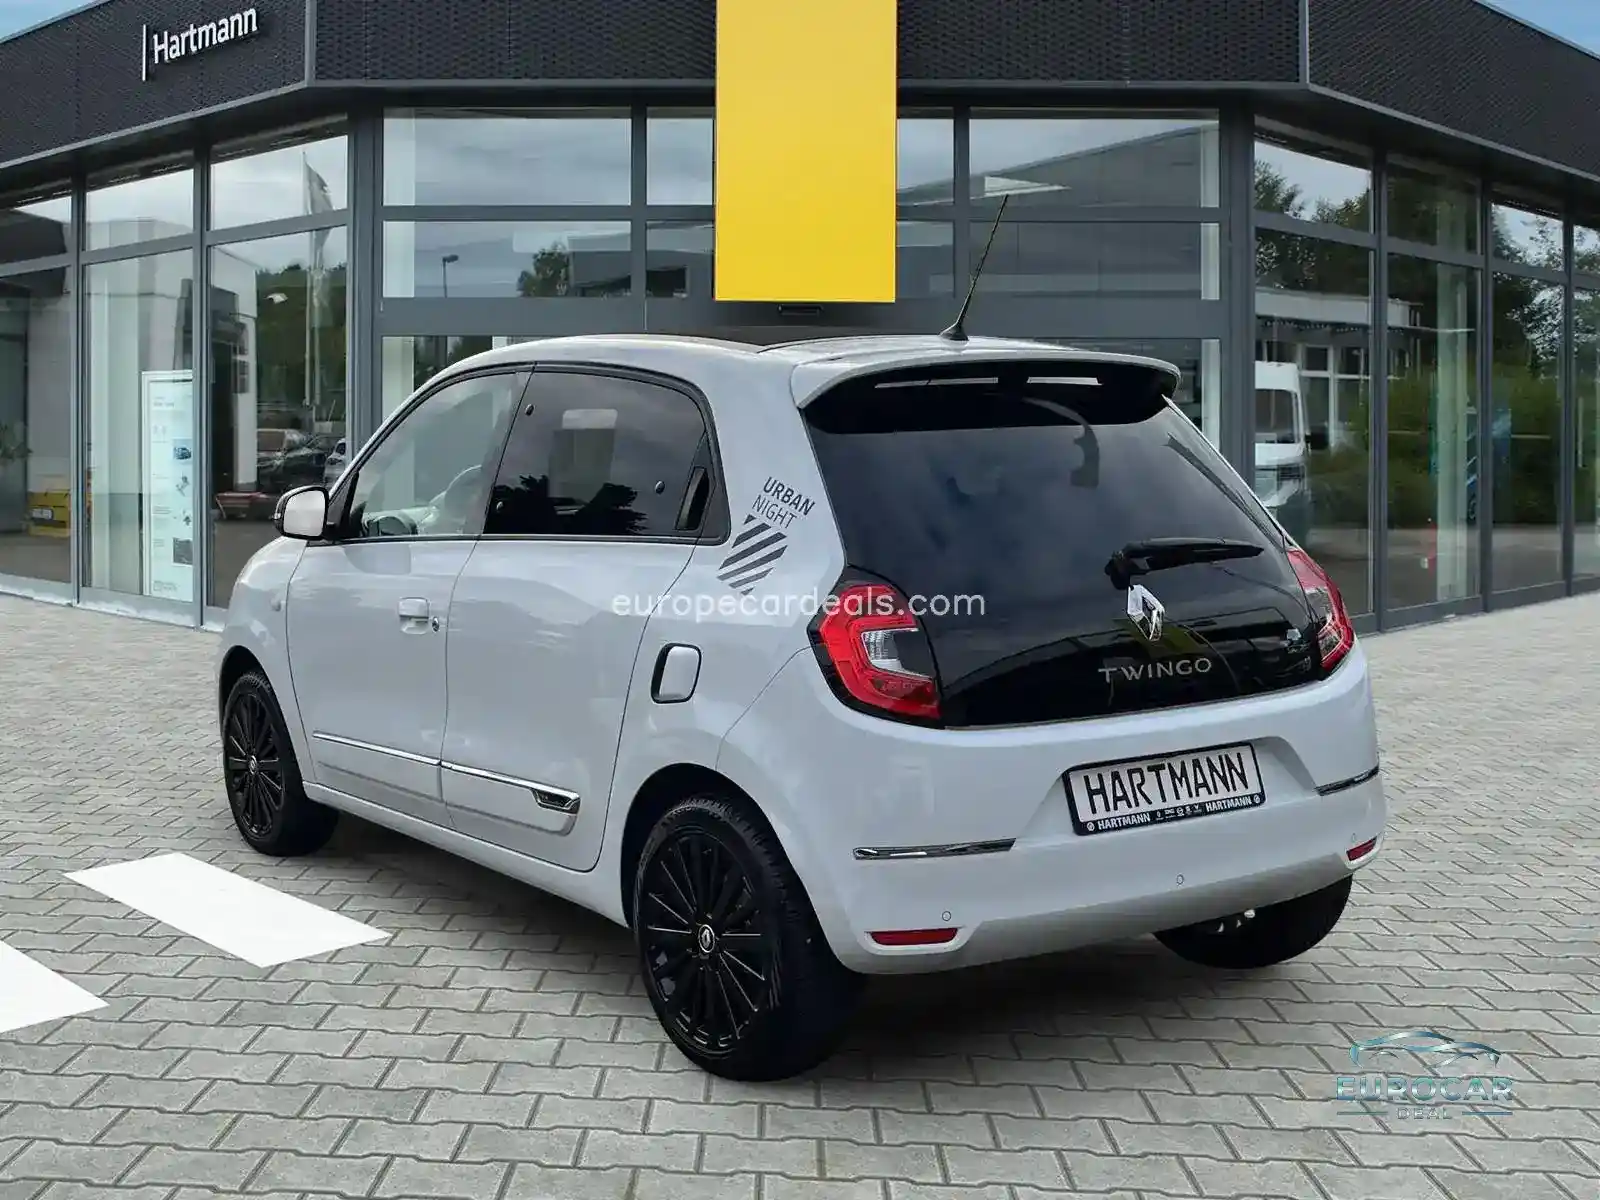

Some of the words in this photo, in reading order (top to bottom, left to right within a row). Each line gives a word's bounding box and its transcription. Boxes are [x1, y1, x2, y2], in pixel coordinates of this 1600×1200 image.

[153, 7, 258, 64] Hartmann
[752, 494, 798, 529] NIGHT
[764, 477, 815, 516] URBAN
[1098, 657, 1212, 683] TWINGO
[1083, 752, 1249, 814] HARTMANN
[1098, 813, 1151, 830] HARTMANN
[1205, 797, 1252, 812] HARTMANN
